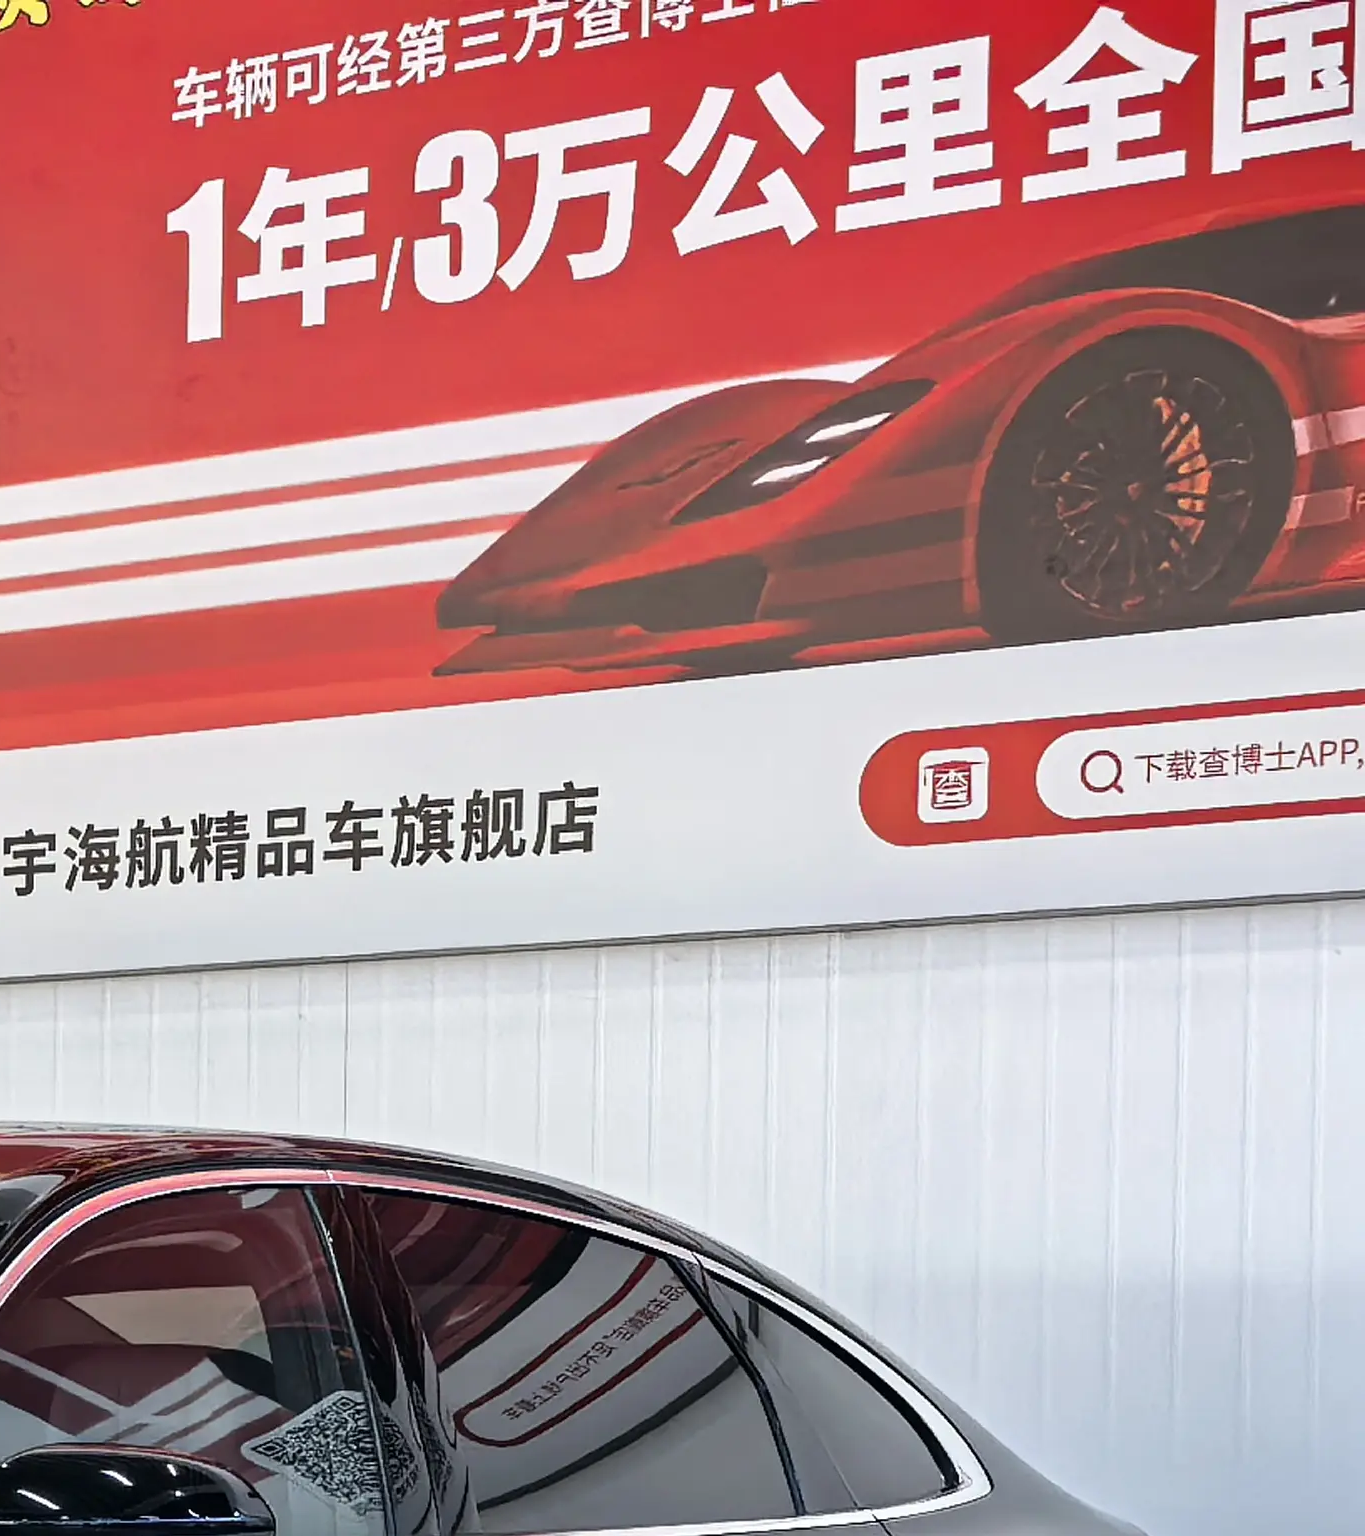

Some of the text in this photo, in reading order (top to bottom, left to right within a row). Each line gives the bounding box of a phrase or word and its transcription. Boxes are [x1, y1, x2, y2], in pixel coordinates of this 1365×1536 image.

[172, 0, 819, 128] 车辆可经第三方查博
[1, 780, 600, 898] 宇海航精品车旗舰店
